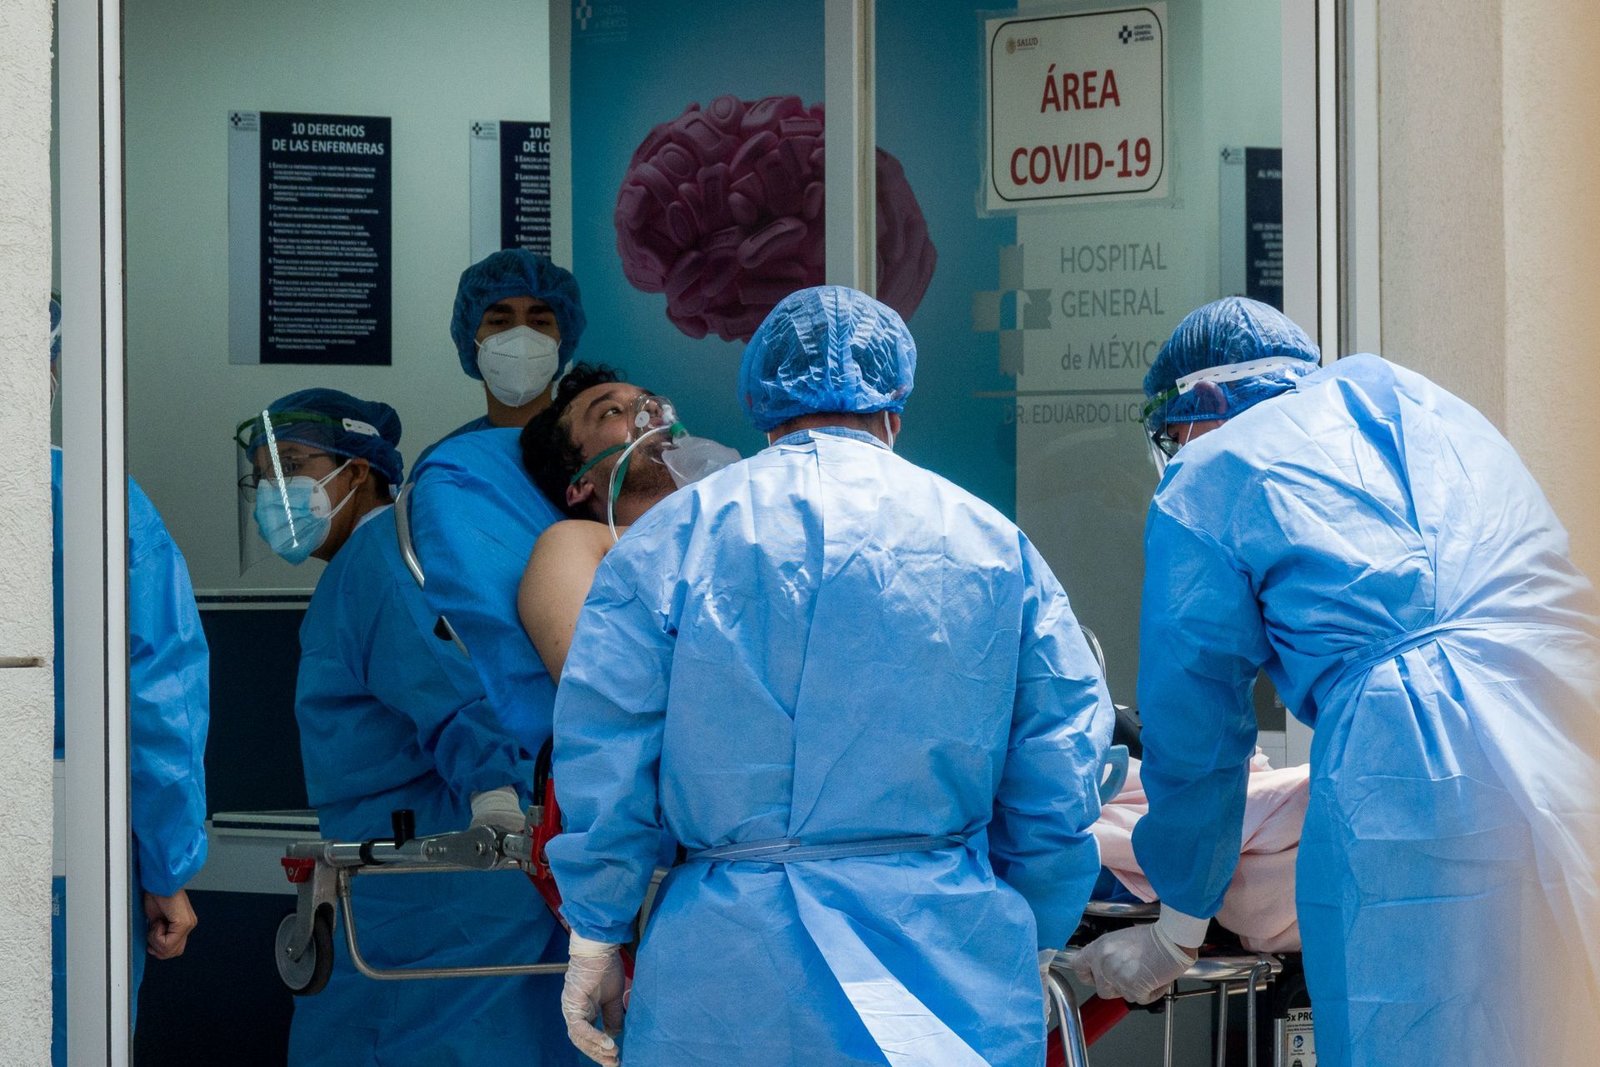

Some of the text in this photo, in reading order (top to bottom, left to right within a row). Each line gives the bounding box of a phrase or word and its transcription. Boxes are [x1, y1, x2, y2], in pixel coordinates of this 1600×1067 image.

[1016, 37, 1039, 48] SALUD
[1040, 63, 1121, 114] ÁREA
[292, 122, 366, 137] 10 DERECHOS
[530, 127, 542, 138] 10
[272, 138, 384, 155] DE LAS ENFERMERAS
[522, 141, 536, 152] DE
[1010, 137, 1151, 186] COVID-19
[1060, 242, 1167, 273] HOSPITAL
[1061, 288, 1165, 318] GENERAL
[1061, 334, 1158, 370] de MÉXIC
[1032, 403, 1111, 424] EDUARDO
[1115, 403, 1140, 422] LIC
